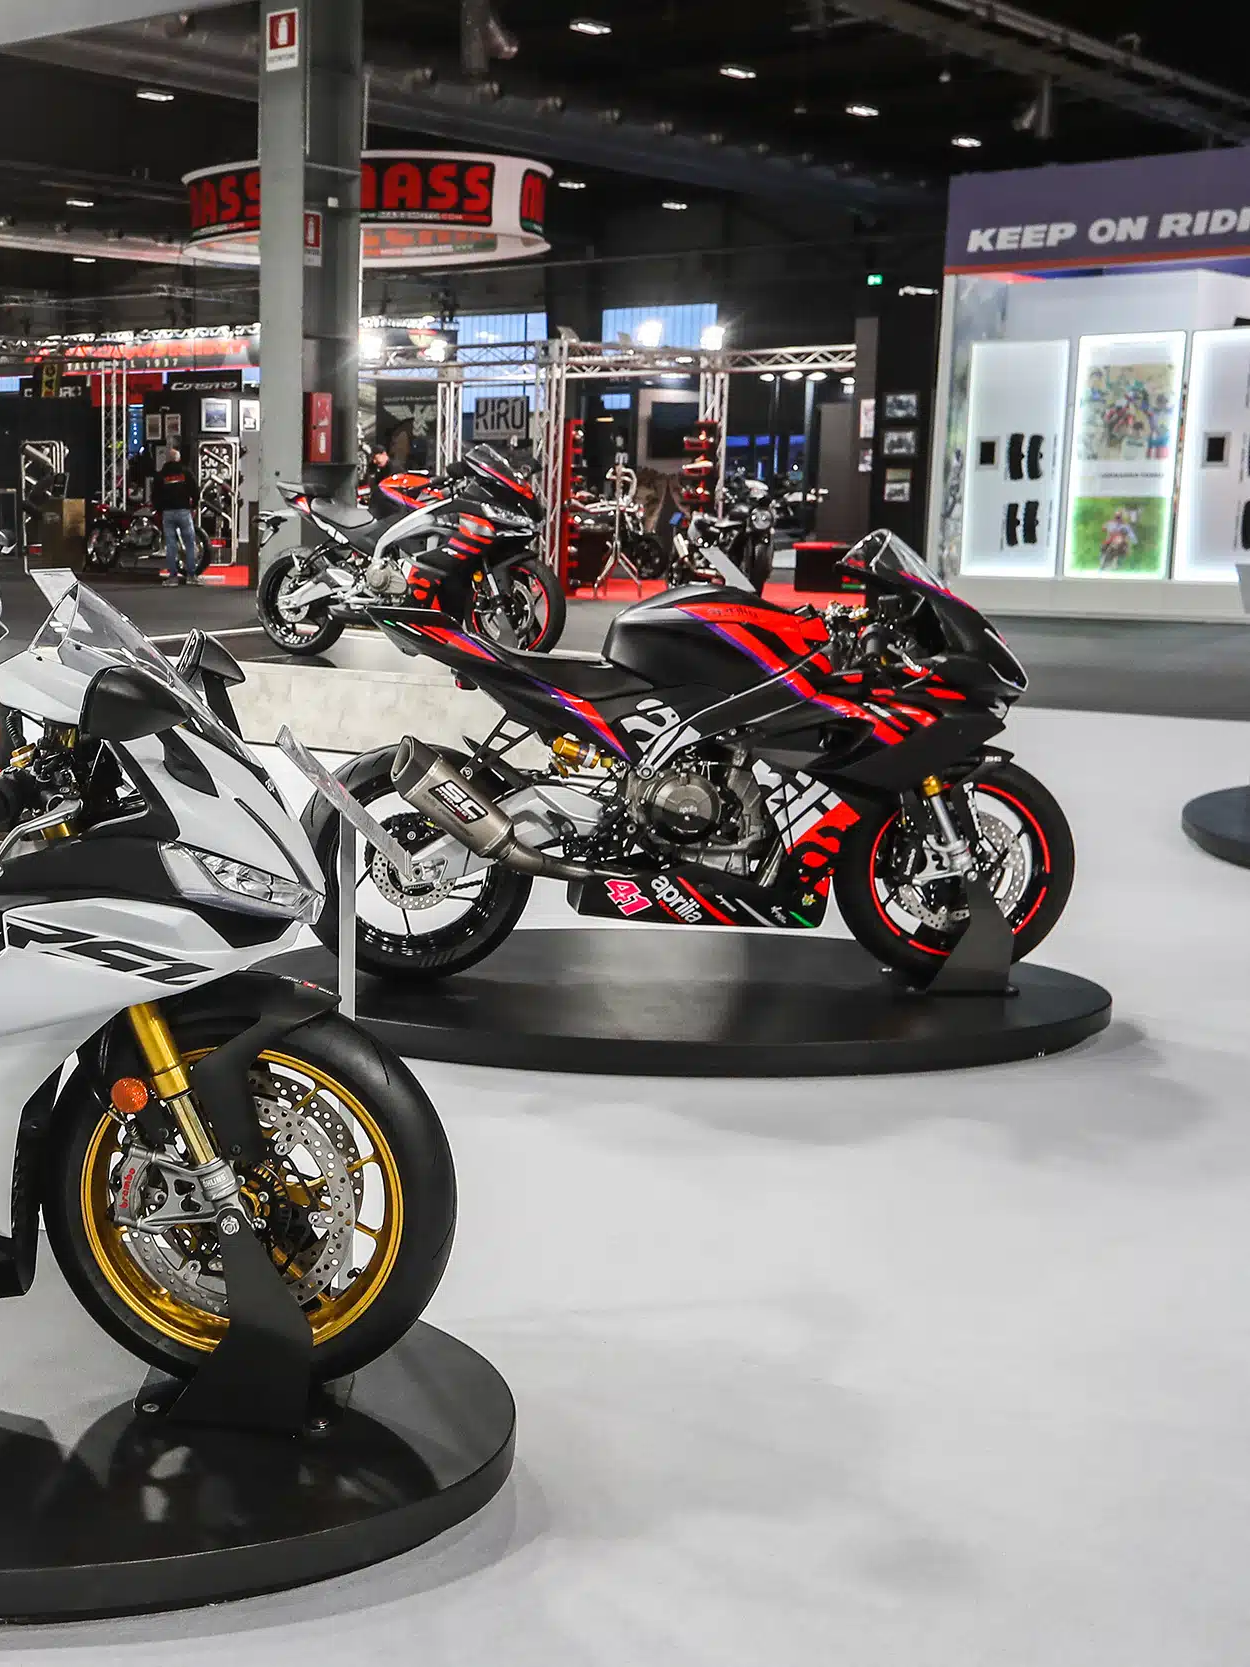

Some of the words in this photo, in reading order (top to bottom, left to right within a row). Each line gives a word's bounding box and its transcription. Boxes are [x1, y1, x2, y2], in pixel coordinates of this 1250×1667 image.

[967, 223, 1077, 252] KEEP
[1088, 216, 1149, 245] ON
[604, 878, 653, 916] 41
[651, 875, 703, 923] aprilia
[119, 1167, 136, 1208] brembo
